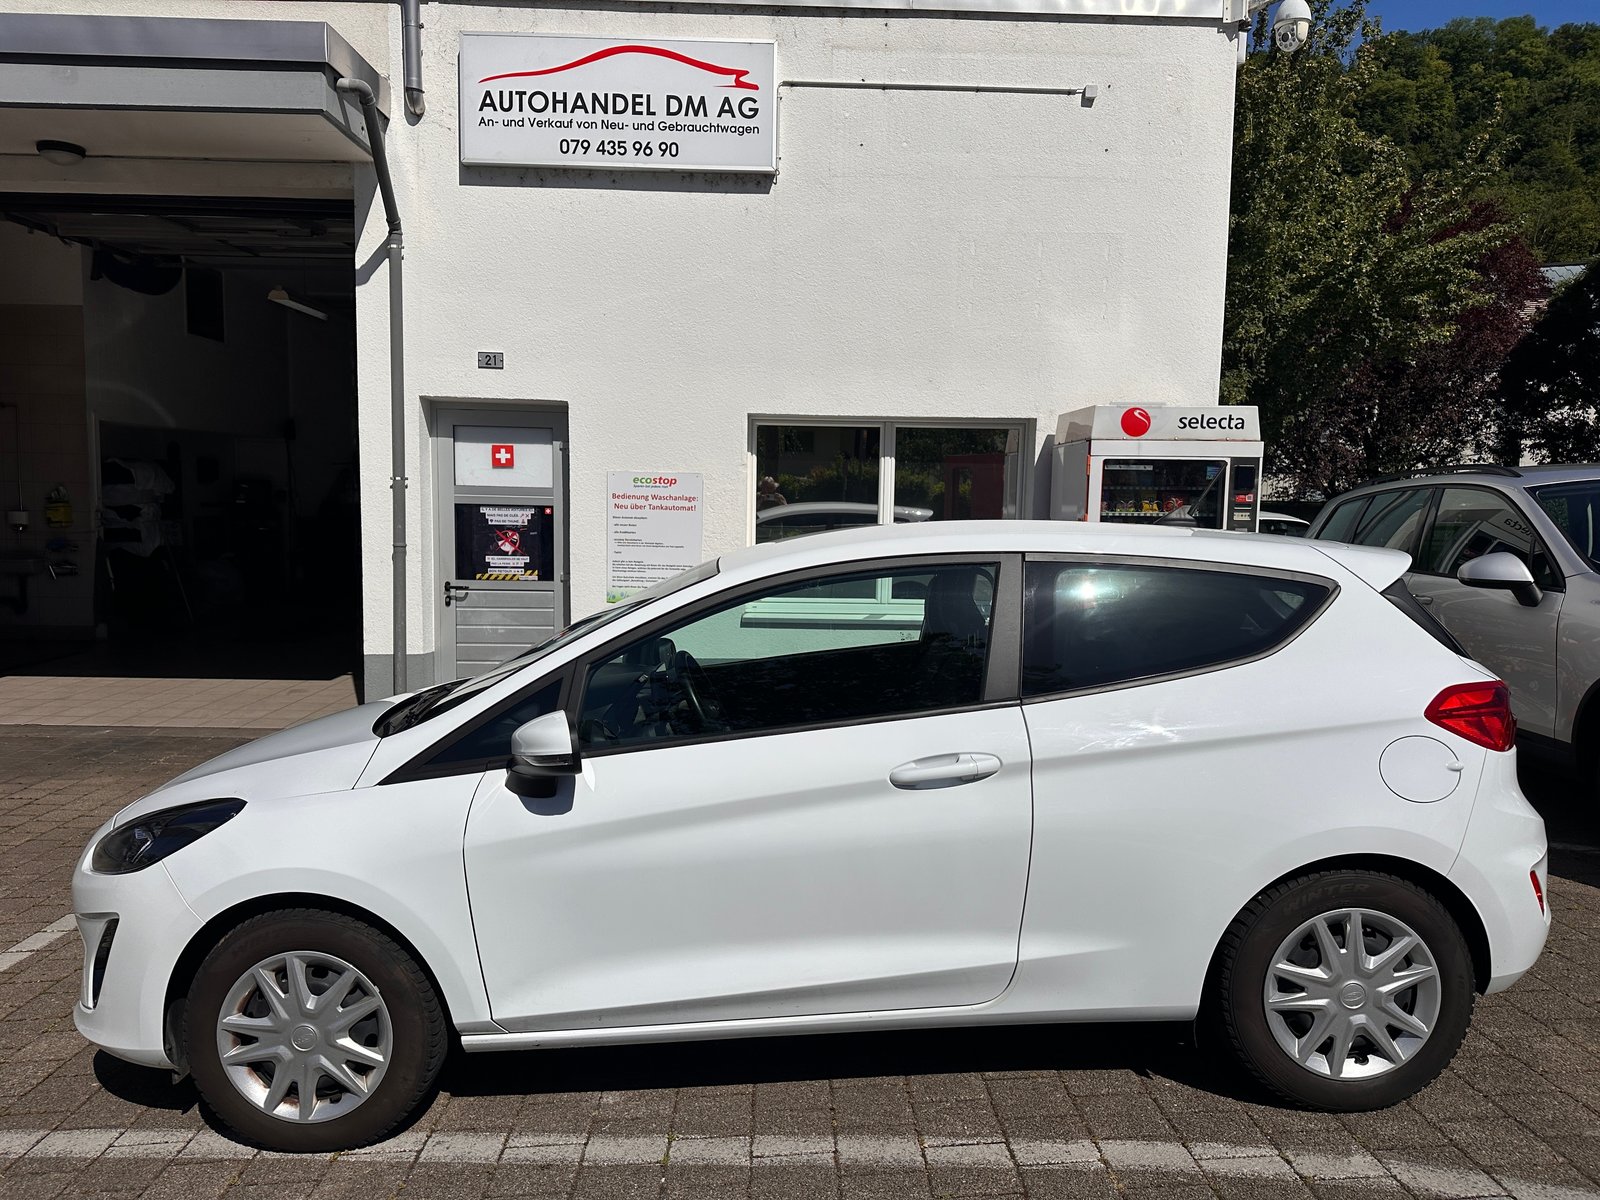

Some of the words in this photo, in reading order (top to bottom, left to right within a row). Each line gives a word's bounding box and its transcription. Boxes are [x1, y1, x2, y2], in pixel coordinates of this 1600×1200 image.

[478, 90, 657, 116] AUTOHANDEL
[665, 94, 708, 118] DM
[717, 96, 760, 120] AG
[478, 116, 499, 127] An-
[502, 116, 525, 128] und
[528, 117, 573, 130] Verkauf
[576, 121, 598, 130] von
[601, 120, 629, 131] Neu-
[632, 120, 655, 132] und
[658, 121, 760, 137] Gebrauchtwagen
[559, 138, 591, 155] 079
[595, 139, 628, 156] 435
[632, 140, 654, 157] 96
[658, 141, 679, 158] 90
[485, 354, 497, 366] 21
[1177, 413, 1245, 430] selecta
[632, 476, 678, 487] ecostop
[611, 493, 650, 502] Bedienung
[650, 494, 699, 503] Waschanlage:
[613, 502, 629, 510] Neu
[629, 503, 646, 511] über
[648, 504, 697, 512] Tankautomat!
[1282, 882, 1370, 914] WINTER
